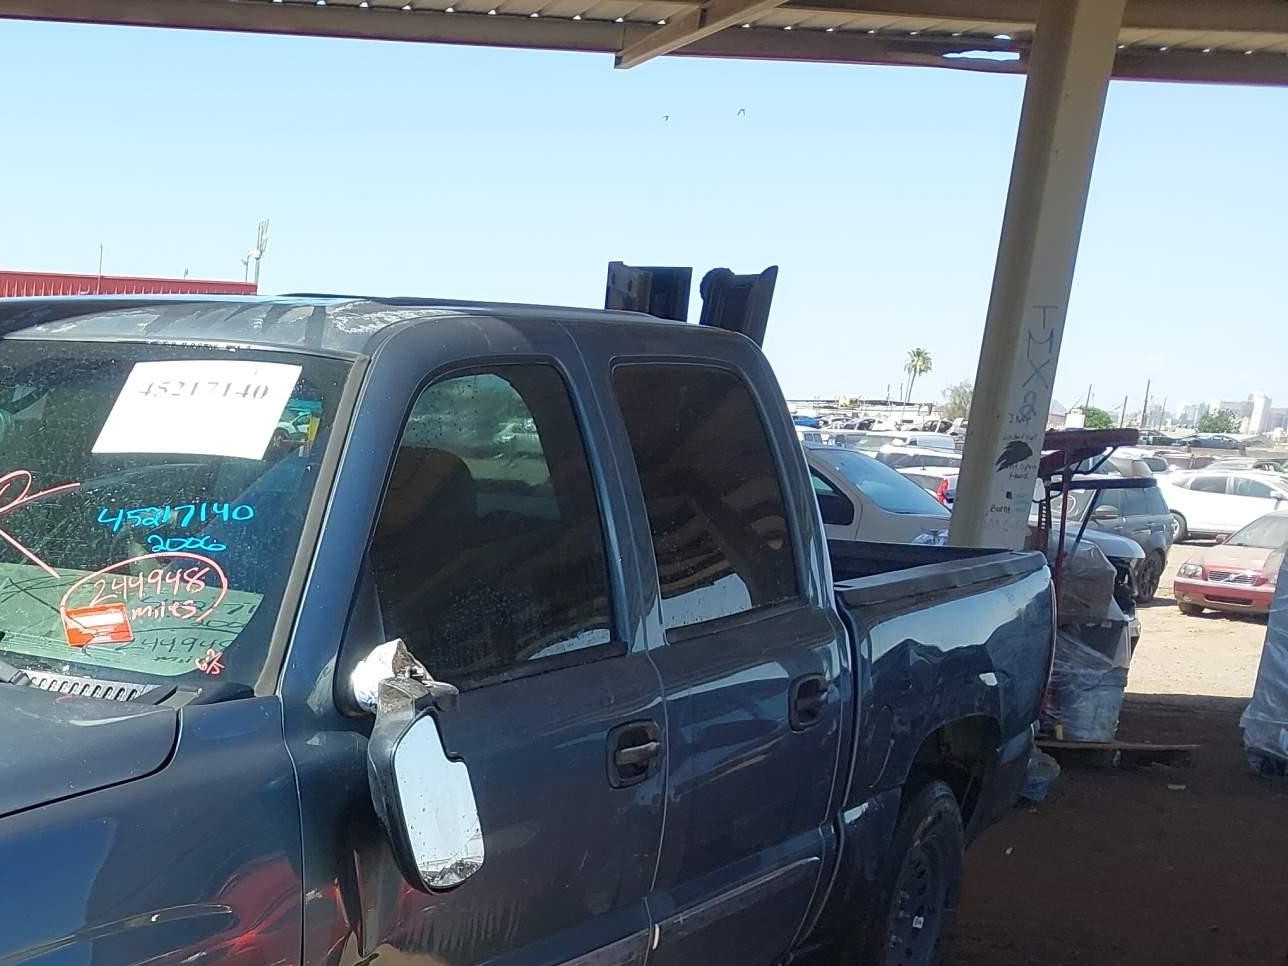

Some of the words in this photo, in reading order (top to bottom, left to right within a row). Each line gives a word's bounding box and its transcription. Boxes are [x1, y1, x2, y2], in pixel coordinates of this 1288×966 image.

[97, 502, 254, 532] 45217140
[147, 534, 227, 552] 2006
[89, 567, 211, 606] 244948
